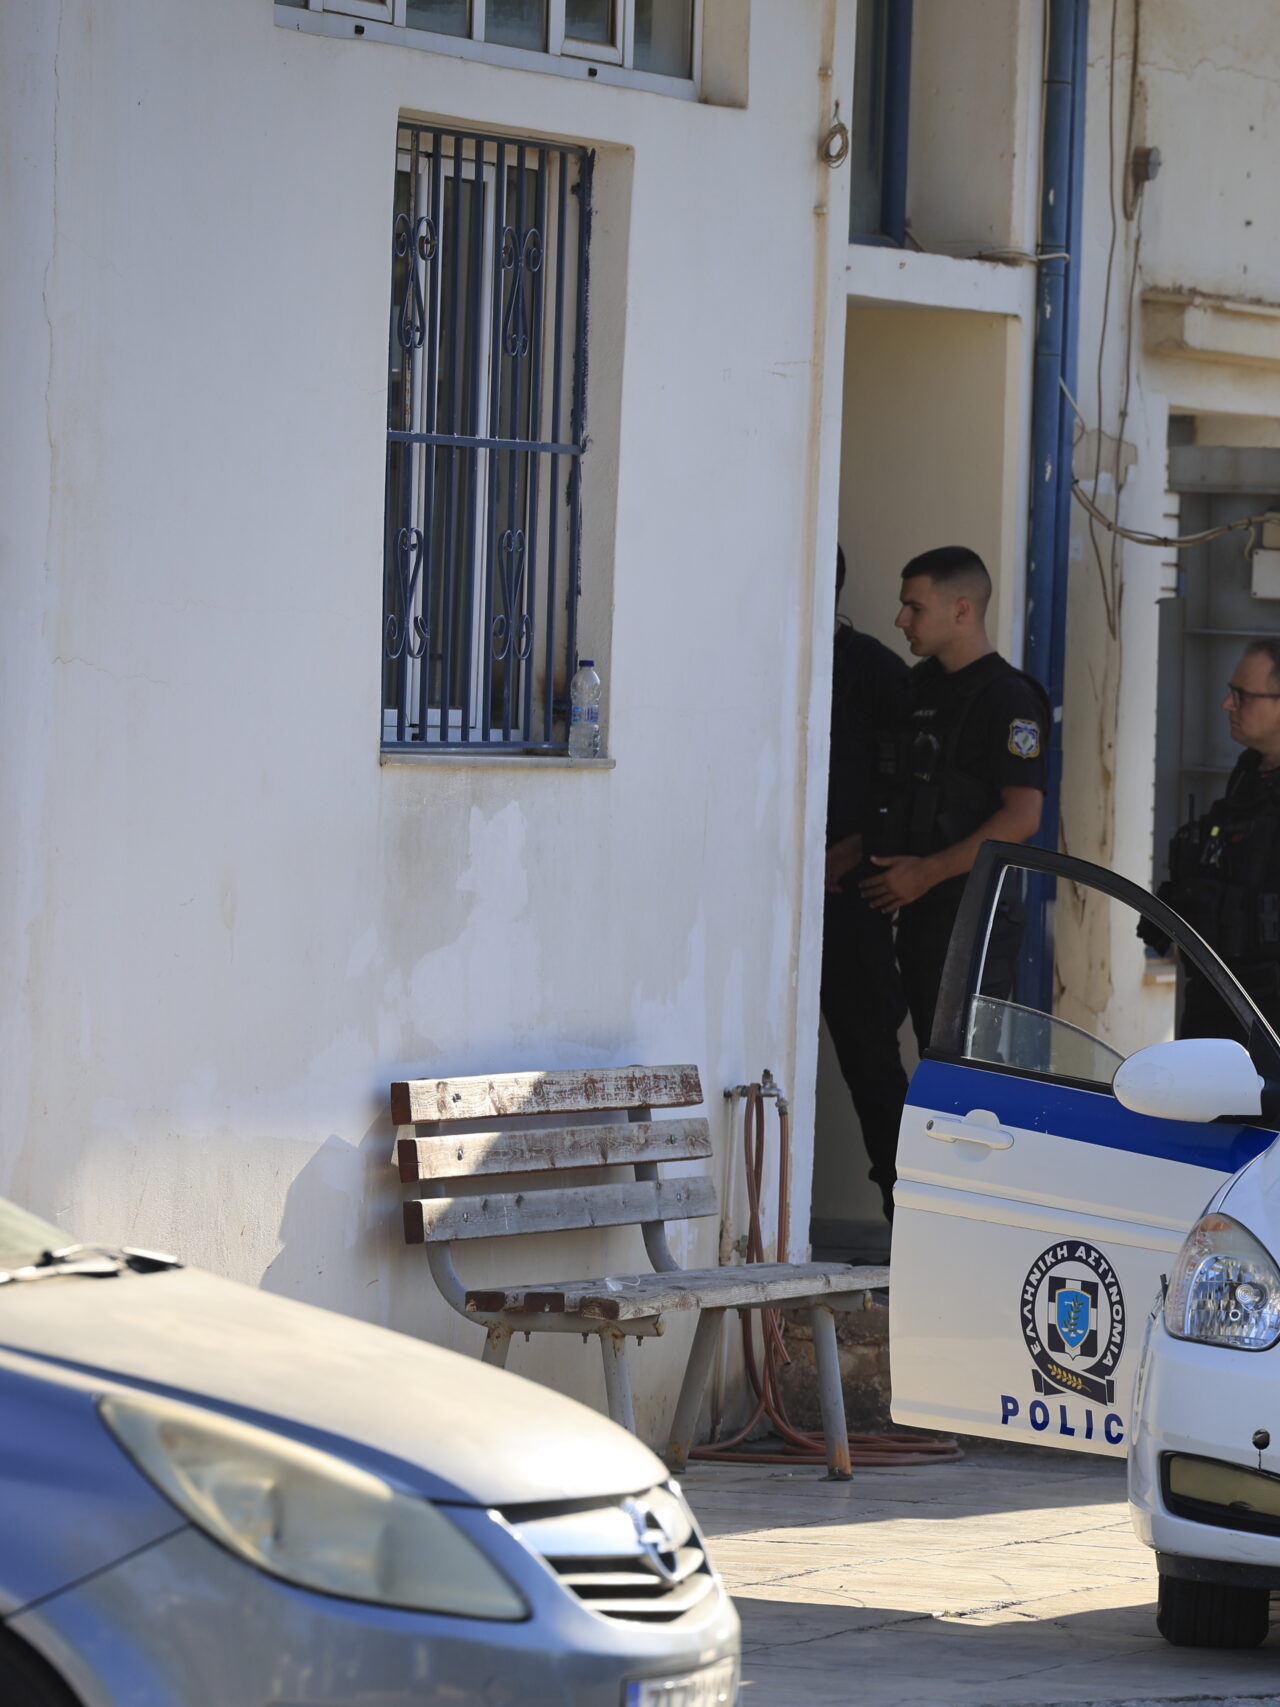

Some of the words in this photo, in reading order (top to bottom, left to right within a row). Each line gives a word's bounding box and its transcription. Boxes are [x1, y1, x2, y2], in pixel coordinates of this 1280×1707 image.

[1022, 1244, 1068, 1356] ΕΛΛΗΝΙΚΗ
[1074, 1245, 1124, 1367] ΑΣΤΥΝΟΜΙΑ
[1000, 1394, 1125, 1445] POLIC
